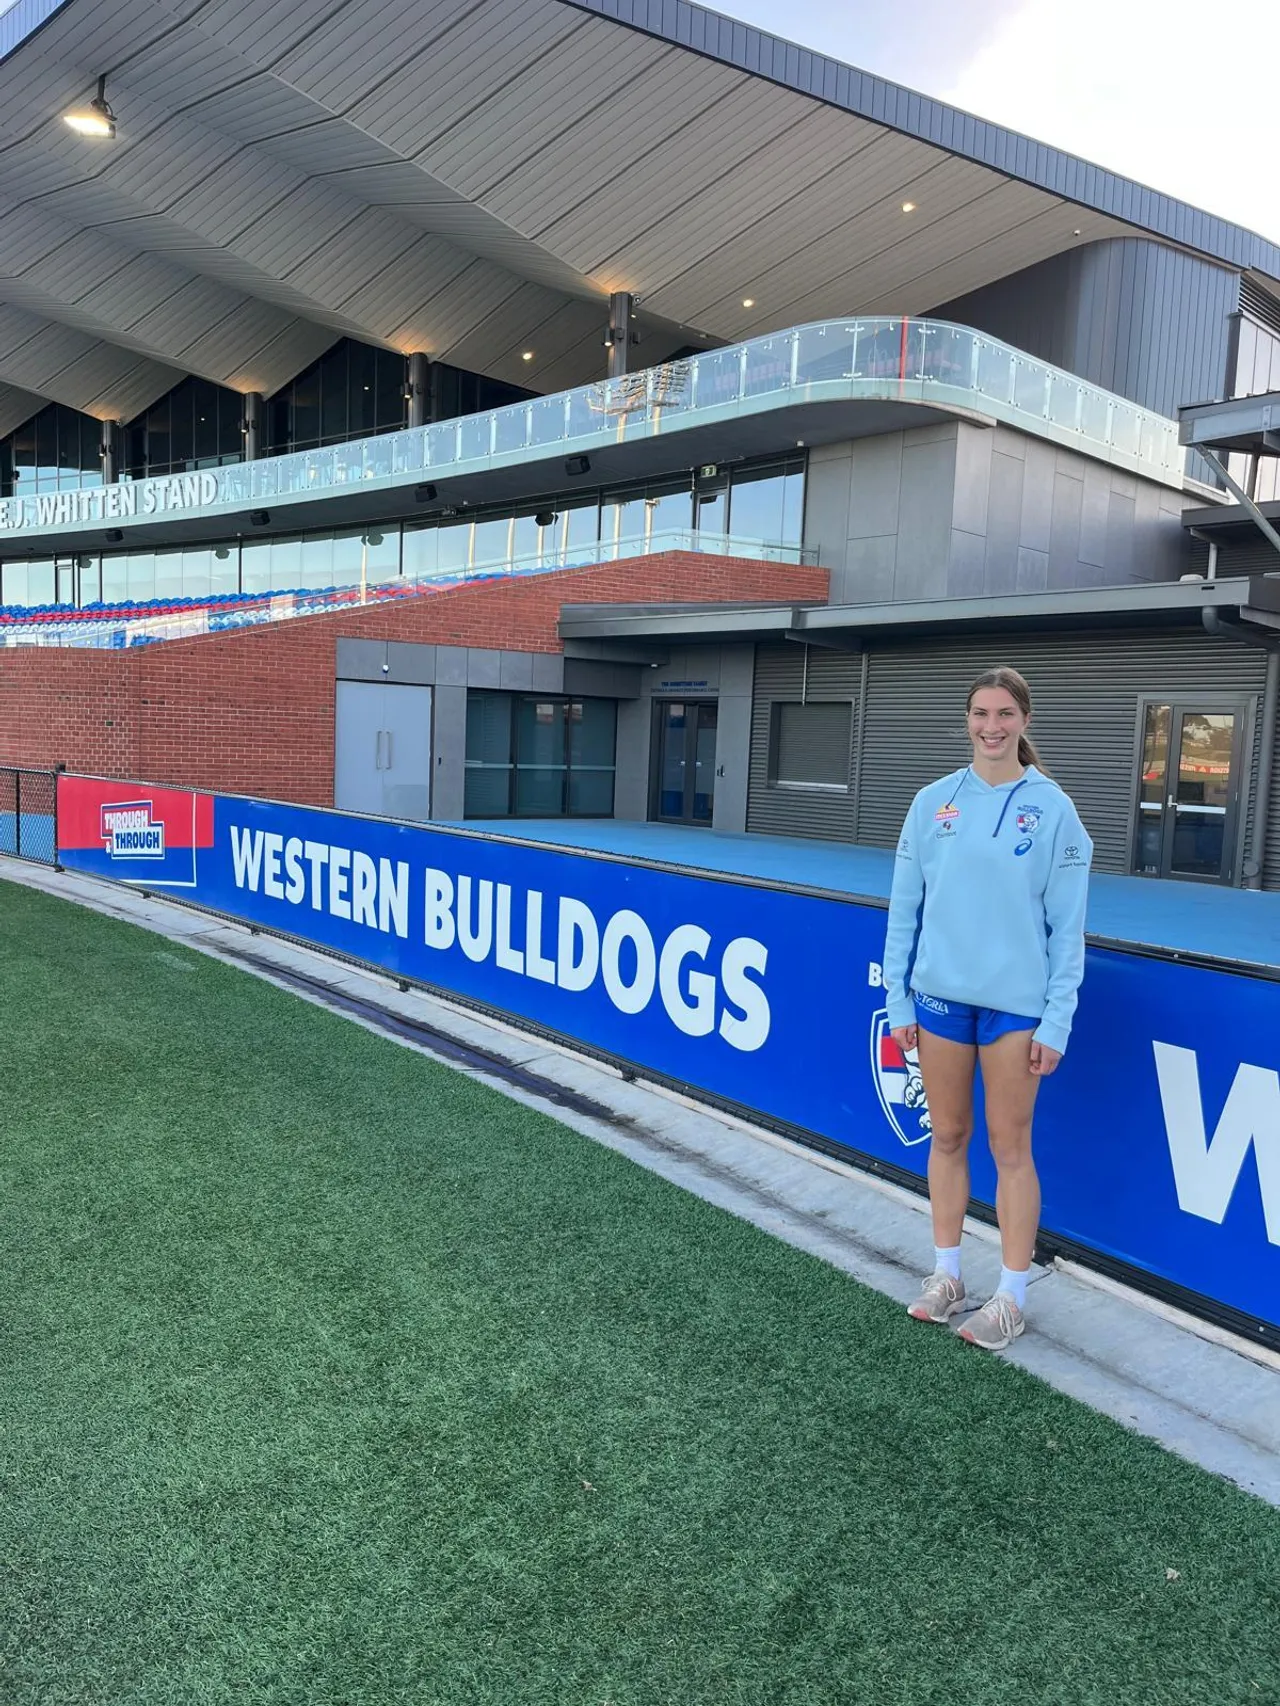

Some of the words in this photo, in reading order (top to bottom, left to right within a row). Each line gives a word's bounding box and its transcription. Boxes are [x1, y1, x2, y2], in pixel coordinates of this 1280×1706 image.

[36, 485, 137, 525] WHITTEN
[143, 473, 219, 514] STAND
[104, 809, 149, 830] THROUGH
[115, 831, 160, 849] THROUGH
[230, 825, 409, 939] WESTERN
[425, 867, 771, 1052] BULLDOGS
[868, 961, 888, 990] B
[914, 991, 949, 1014] CTORIA
